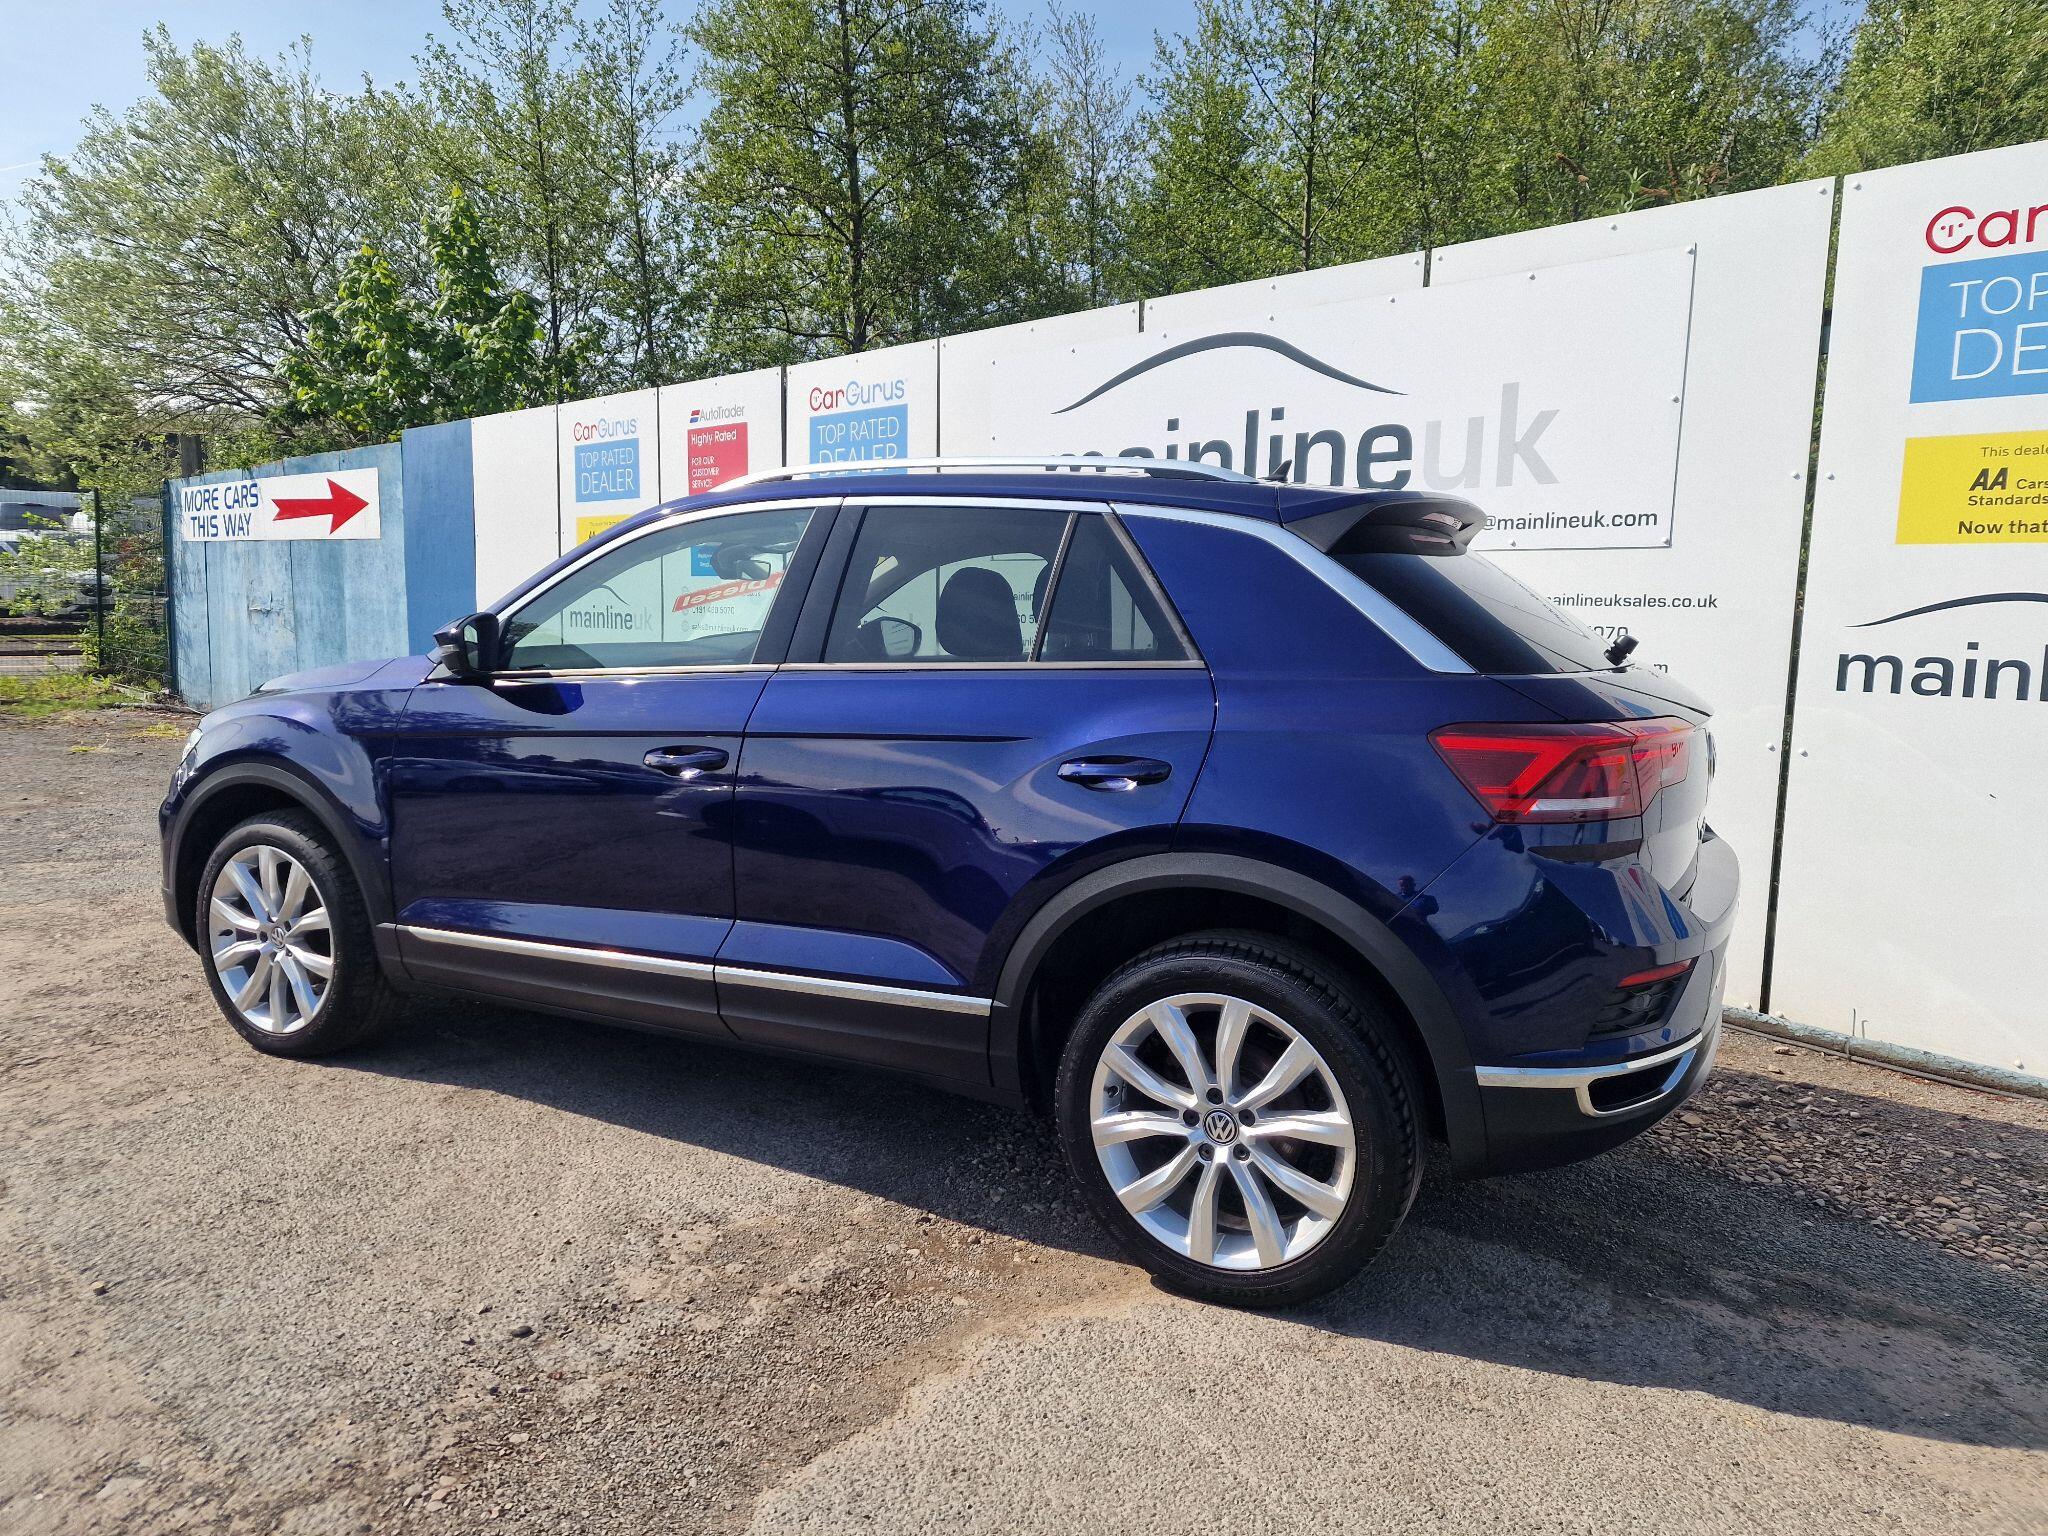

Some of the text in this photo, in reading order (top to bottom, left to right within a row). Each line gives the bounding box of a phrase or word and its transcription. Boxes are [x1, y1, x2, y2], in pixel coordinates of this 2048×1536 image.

[808, 379, 906, 411] CarGurus
[700, 404, 746, 421] AutoTrader
[573, 418, 638, 441] CarGurus
[691, 428, 737, 447] Highly Rated
[817, 416, 900, 445] TOP RATED
[580, 447, 634, 468] TOP RATED
[1980, 446, 2010, 457] This
[581, 468, 634, 494] DEALER
[691, 466, 719, 478] CUSTOMER
[1968, 467, 2009, 491] AA
[691, 479, 713, 489] SERVICE
[184, 482, 259, 512] MORE CARS
[191, 512, 252, 538] THIS WAY
[1958, 520, 2003, 534] Now
[569, 604, 653, 632] mainlineuk
